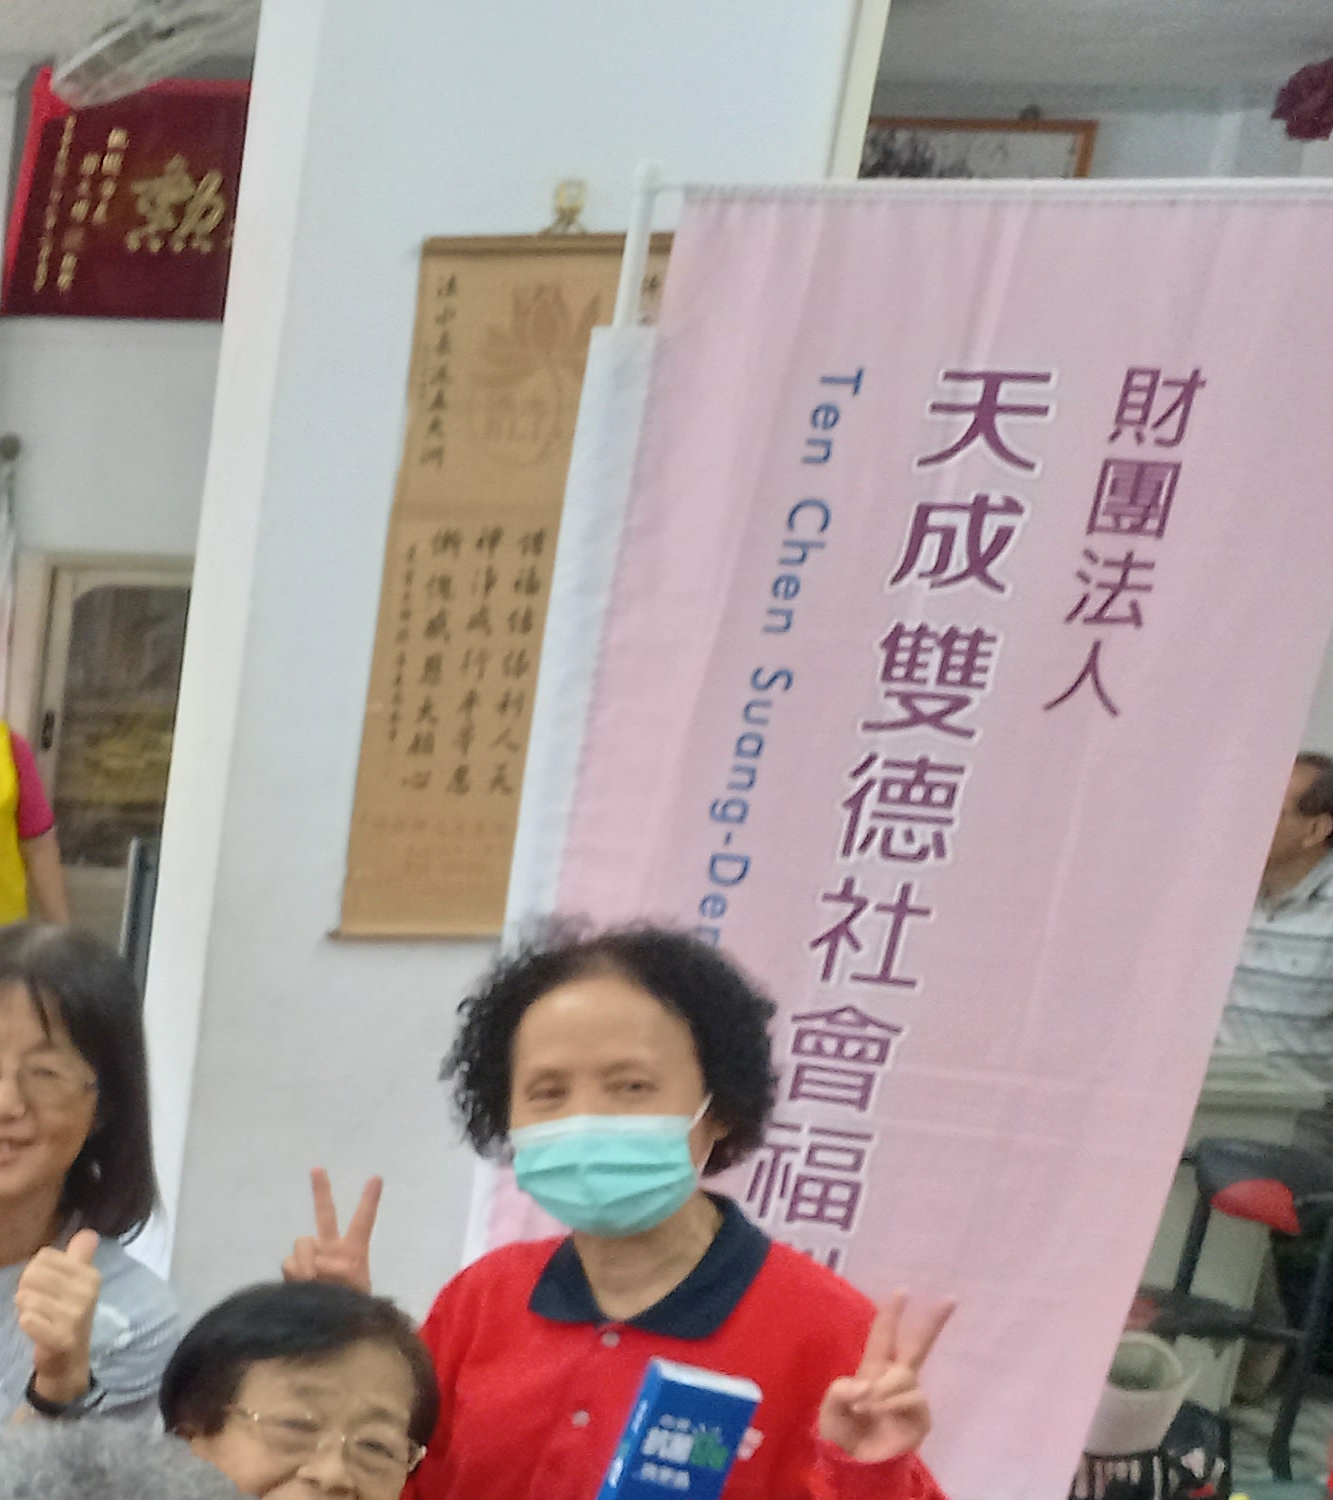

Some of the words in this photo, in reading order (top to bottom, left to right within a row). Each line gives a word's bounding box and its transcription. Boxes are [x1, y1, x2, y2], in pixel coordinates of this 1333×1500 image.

[801, 367, 864, 466] Ten
[762, 498, 832, 636] Chen
[1043, 365, 1207, 722] 財團法人
[745, 367, 1055, 1268] 天成雙德社會福
